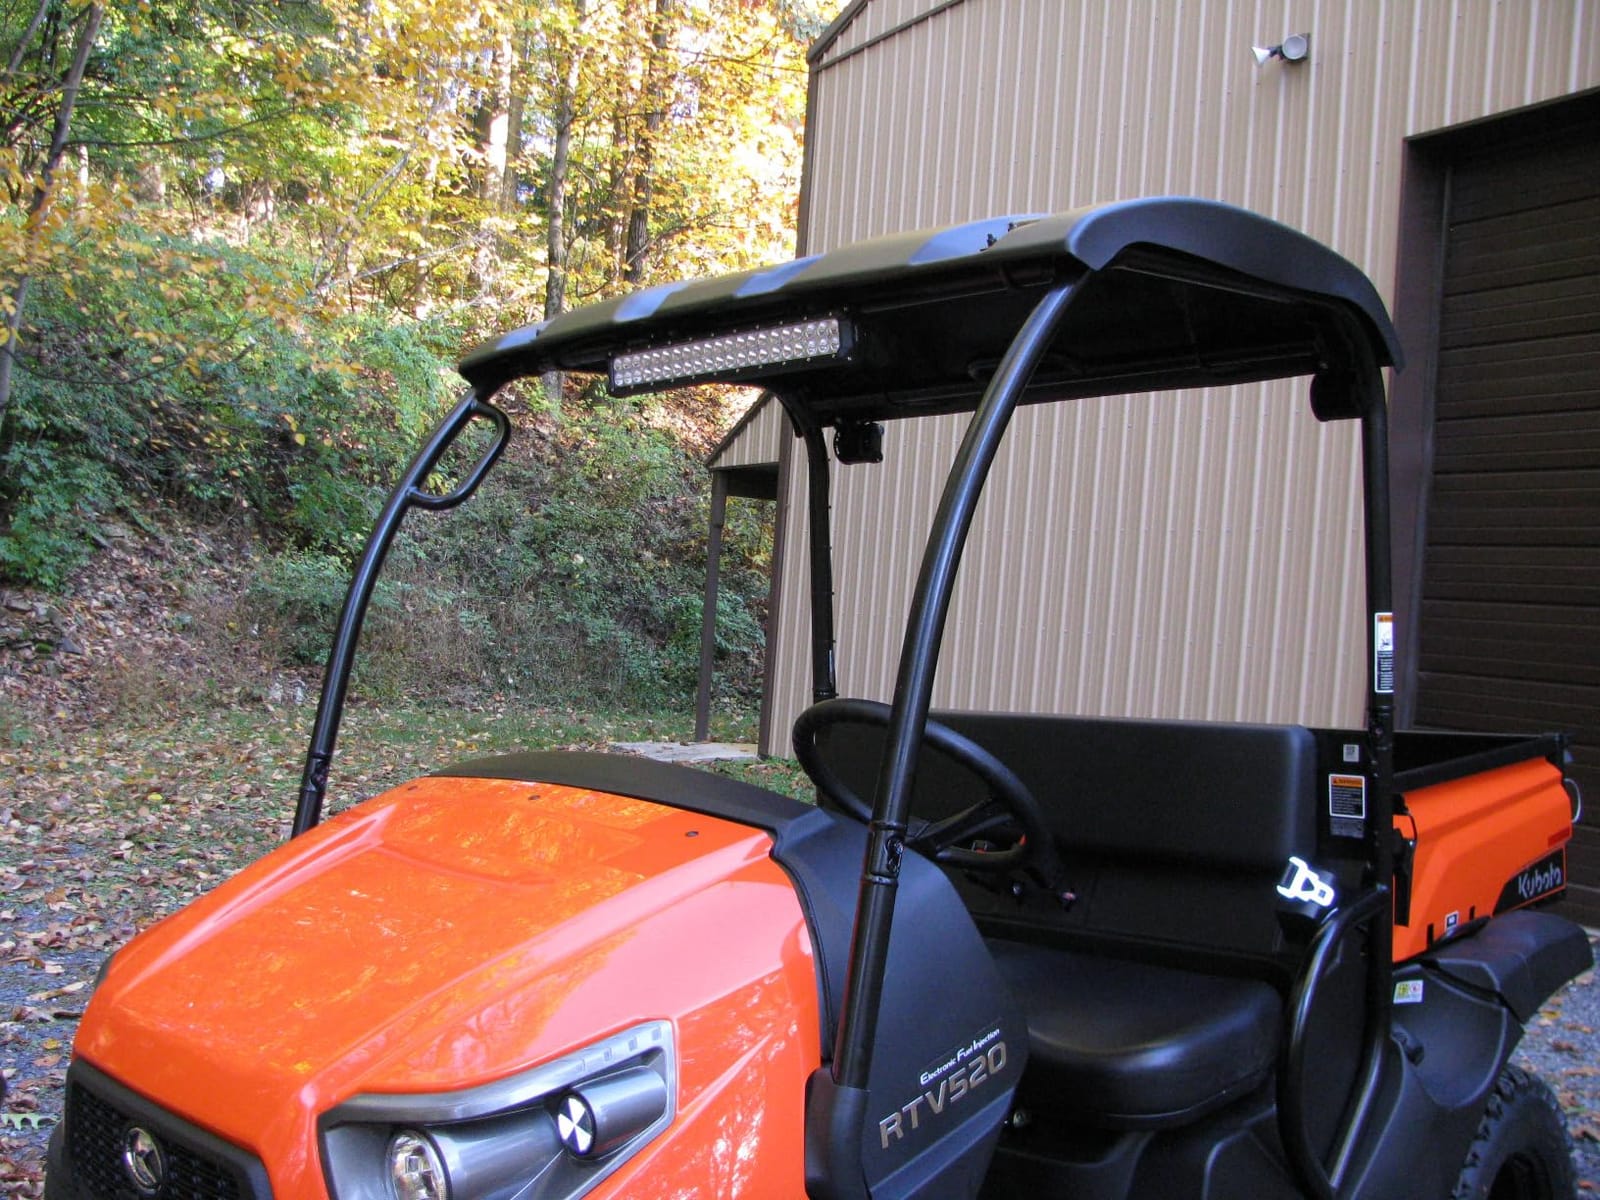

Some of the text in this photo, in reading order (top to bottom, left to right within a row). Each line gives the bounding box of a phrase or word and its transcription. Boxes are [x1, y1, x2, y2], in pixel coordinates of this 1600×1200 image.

[1518, 862, 1562, 899] Kubota
[920, 1028, 1000, 1086] Electronic Fuel Injection
[879, 1041, 1007, 1149] RTV520
